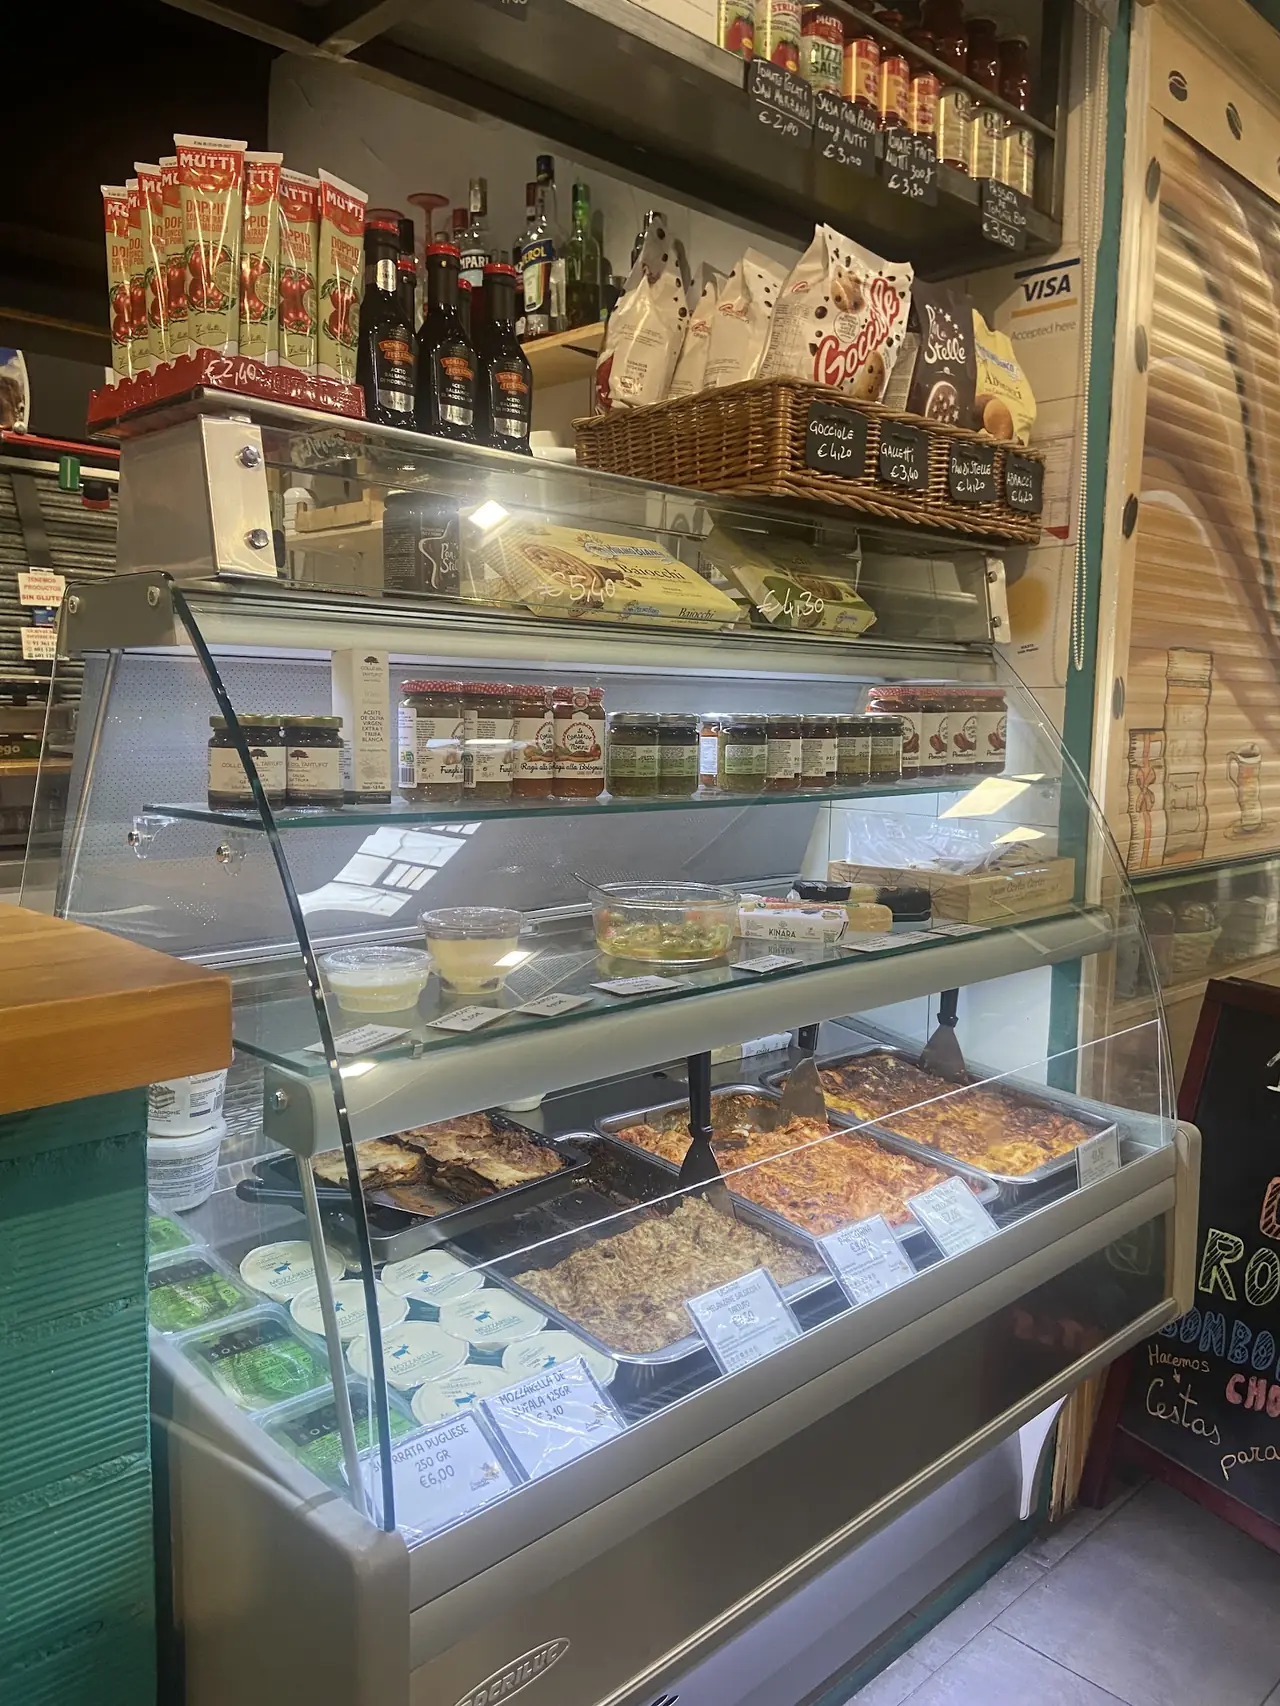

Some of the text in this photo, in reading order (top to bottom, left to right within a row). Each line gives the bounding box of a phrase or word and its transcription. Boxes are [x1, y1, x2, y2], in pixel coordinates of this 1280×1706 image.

[180, 152, 235, 172] MUTTI
[280, 183, 314, 205] UTTI
[326, 190, 364, 222] MUTTI
[460, 254, 489, 271] MPARI
[1023, 274, 1071, 302] VISA
[1011, 320, 1077, 342] Accepted here
[924, 337, 966, 365] Stelle
[36, 594, 62, 602] GLUTE
[768, 928, 797, 939] KINARA
[1198, 1228, 1280, 1307] RO
[389, 1350, 439, 1373] MOZZARELLA
[1148, 1344, 1210, 1373] Hacemos
[499, 1375, 554, 1406] MOZZARELLA
[1225, 1373, 1280, 1418] CHO
[1146, 1378, 1221, 1446] Cestas
[426, 1422, 470, 1449] PUGLIESE
[414, 1448, 451, 1474] 250 GR
[419, 1464, 456, 1489] €6,00
